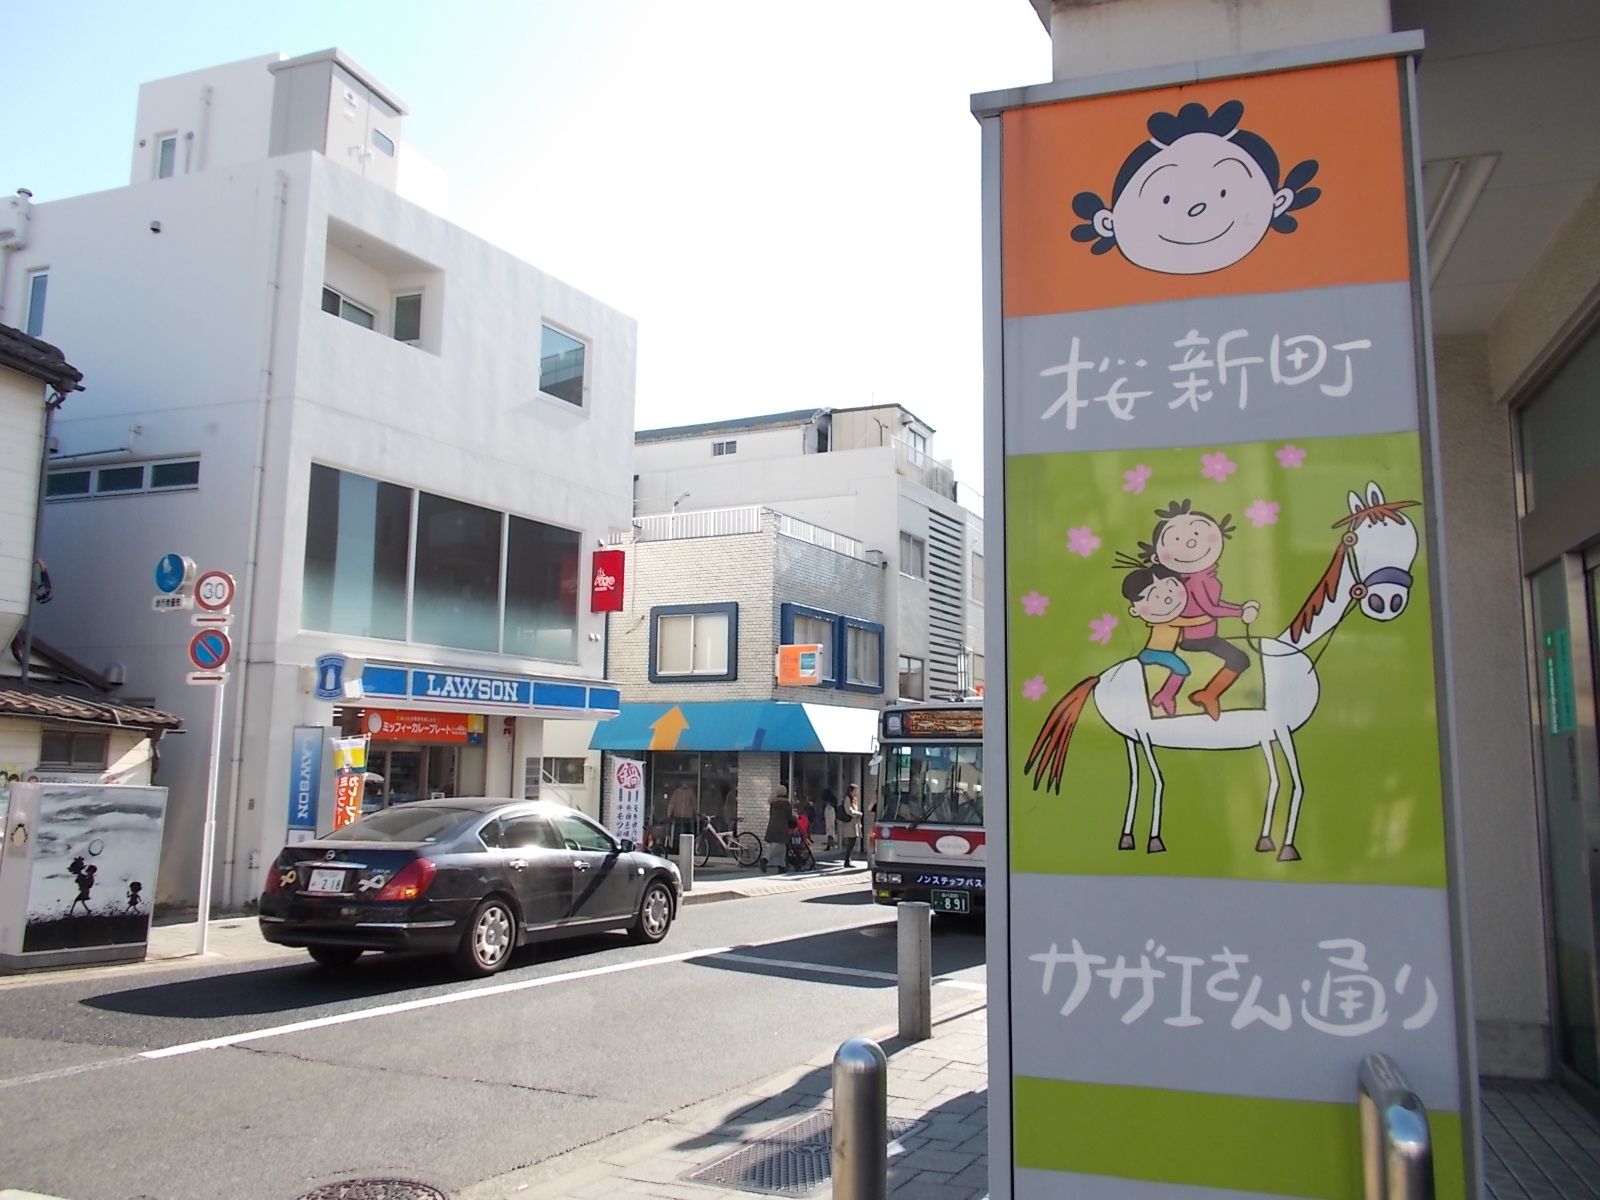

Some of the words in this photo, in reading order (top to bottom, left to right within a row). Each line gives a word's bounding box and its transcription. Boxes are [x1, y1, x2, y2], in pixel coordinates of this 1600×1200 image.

[1039, 328, 1372, 430] 桜新町
[203, 583, 225, 600] 30
[426, 674, 519, 702] LAWSON
[382, 721, 452, 735] ミッフィーカレープレート
[296, 739, 313, 819] LAWSON
[916, 874, 983, 888] ノンステップバス
[944, 898, 966, 911] 891
[1028, 938, 1438, 1036] サザエさん通り
